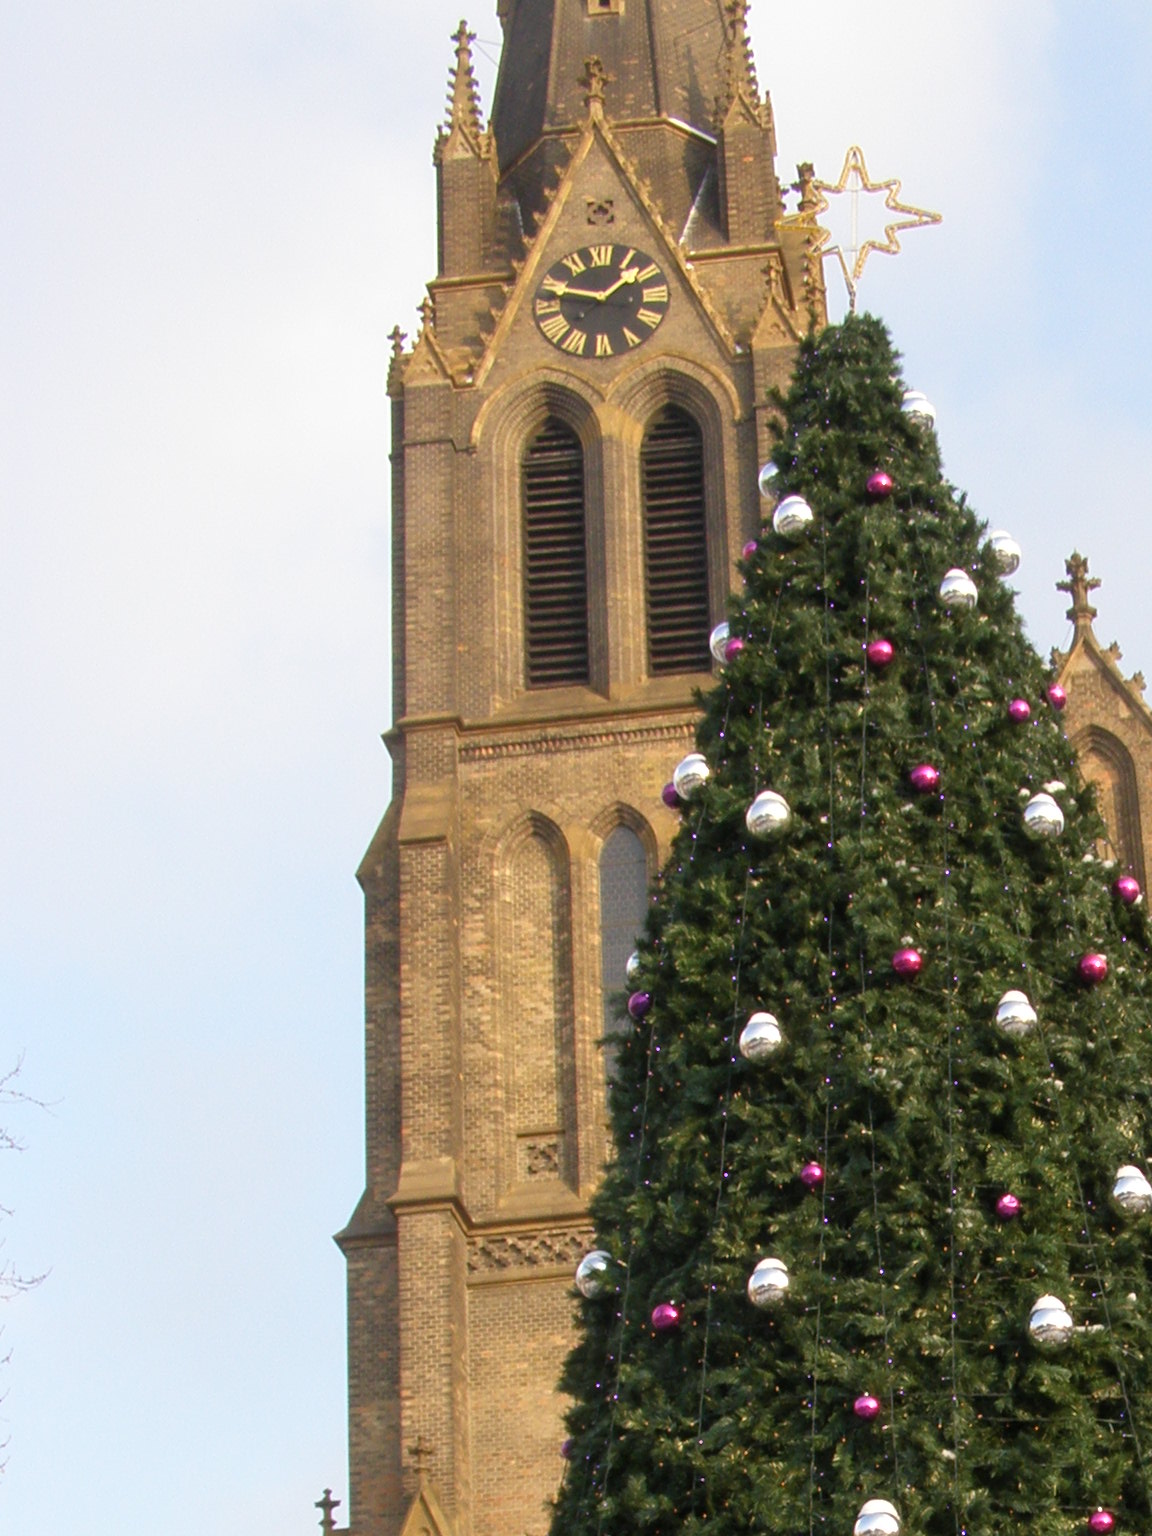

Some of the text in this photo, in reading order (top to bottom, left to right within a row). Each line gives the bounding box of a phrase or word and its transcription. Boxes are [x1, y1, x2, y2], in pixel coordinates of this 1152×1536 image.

[562, 253, 586, 277] XI
[589, 246, 613, 267] XII
[636, 262, 661, 284] II
[642, 284, 668, 303] III
[540, 314, 570, 344] VIII
[623, 327, 641, 347] V
[562, 329, 587, 355] VII
